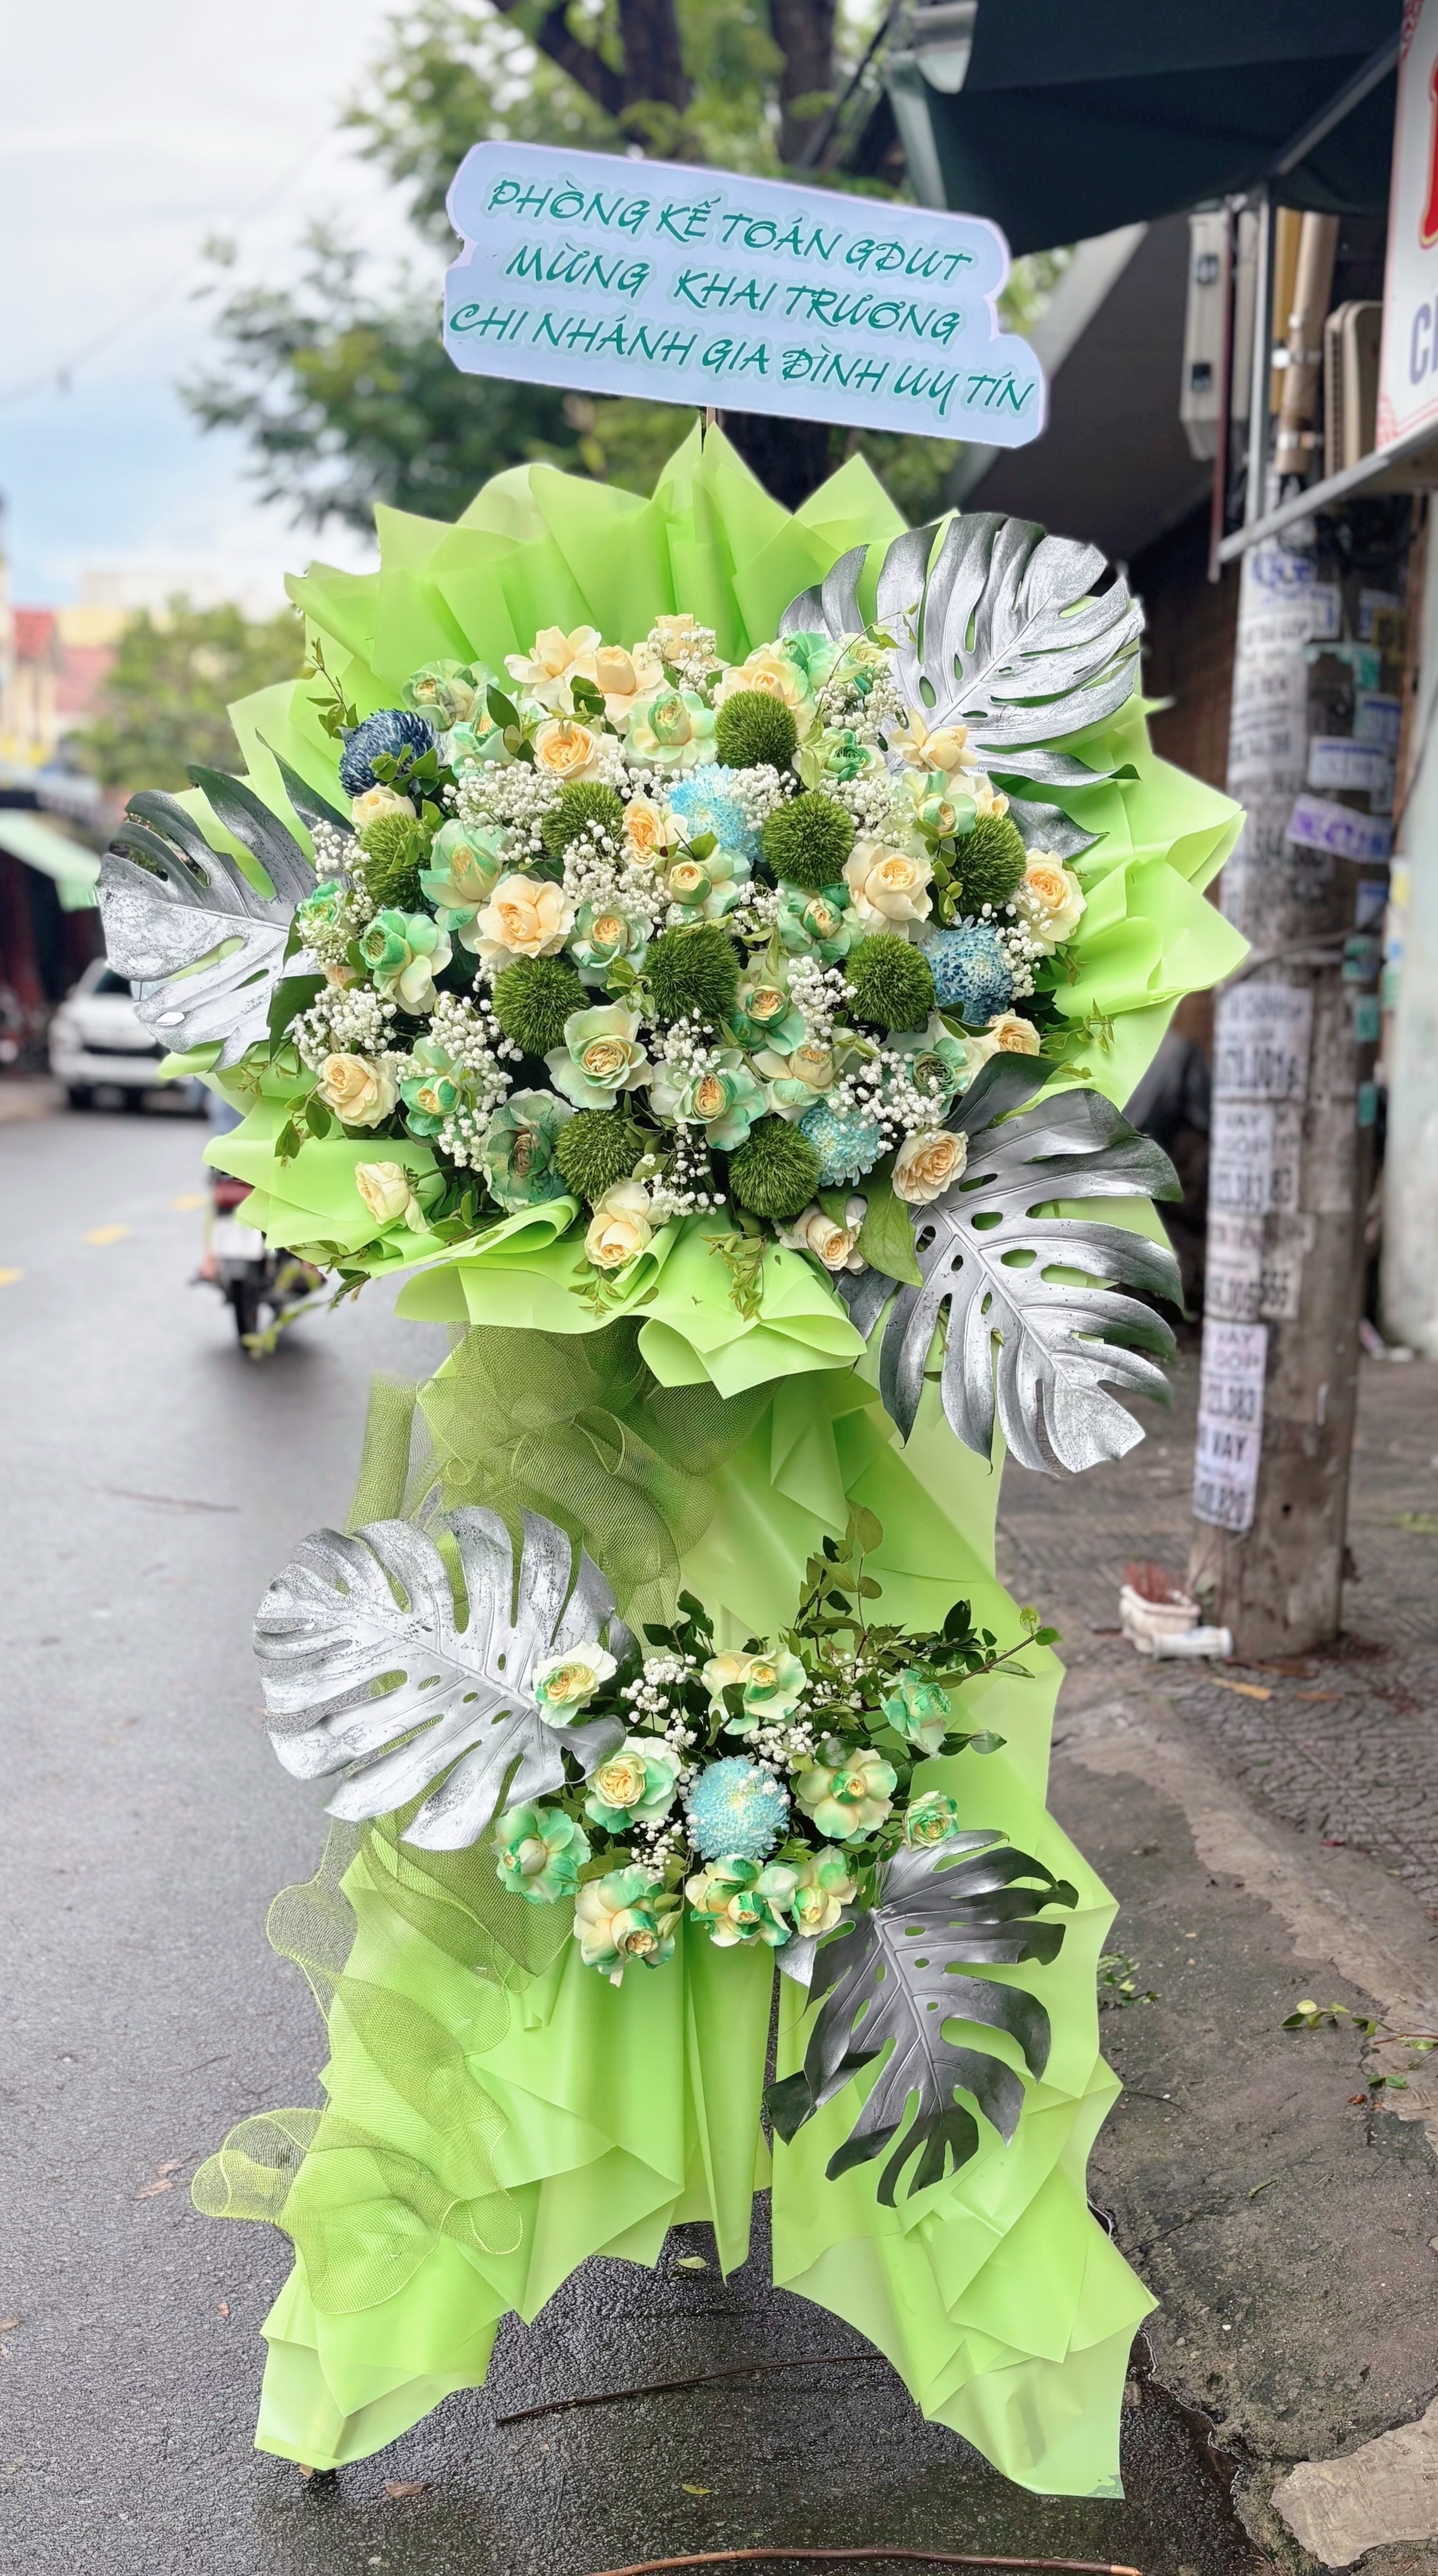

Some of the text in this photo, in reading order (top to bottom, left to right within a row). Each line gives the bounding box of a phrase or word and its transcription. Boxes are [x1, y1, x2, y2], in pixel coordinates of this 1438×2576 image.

[488, 178, 650, 228] PHÒNG
[656, 197, 721, 239] KẾ
[722, 212, 842, 260] TOÁN
[506, 242, 960, 345] MỪNG KHAI TRƯƠNG
[450, 303, 1035, 415] CHI NHÁNH GIA ĐÌNH UY TÍN
